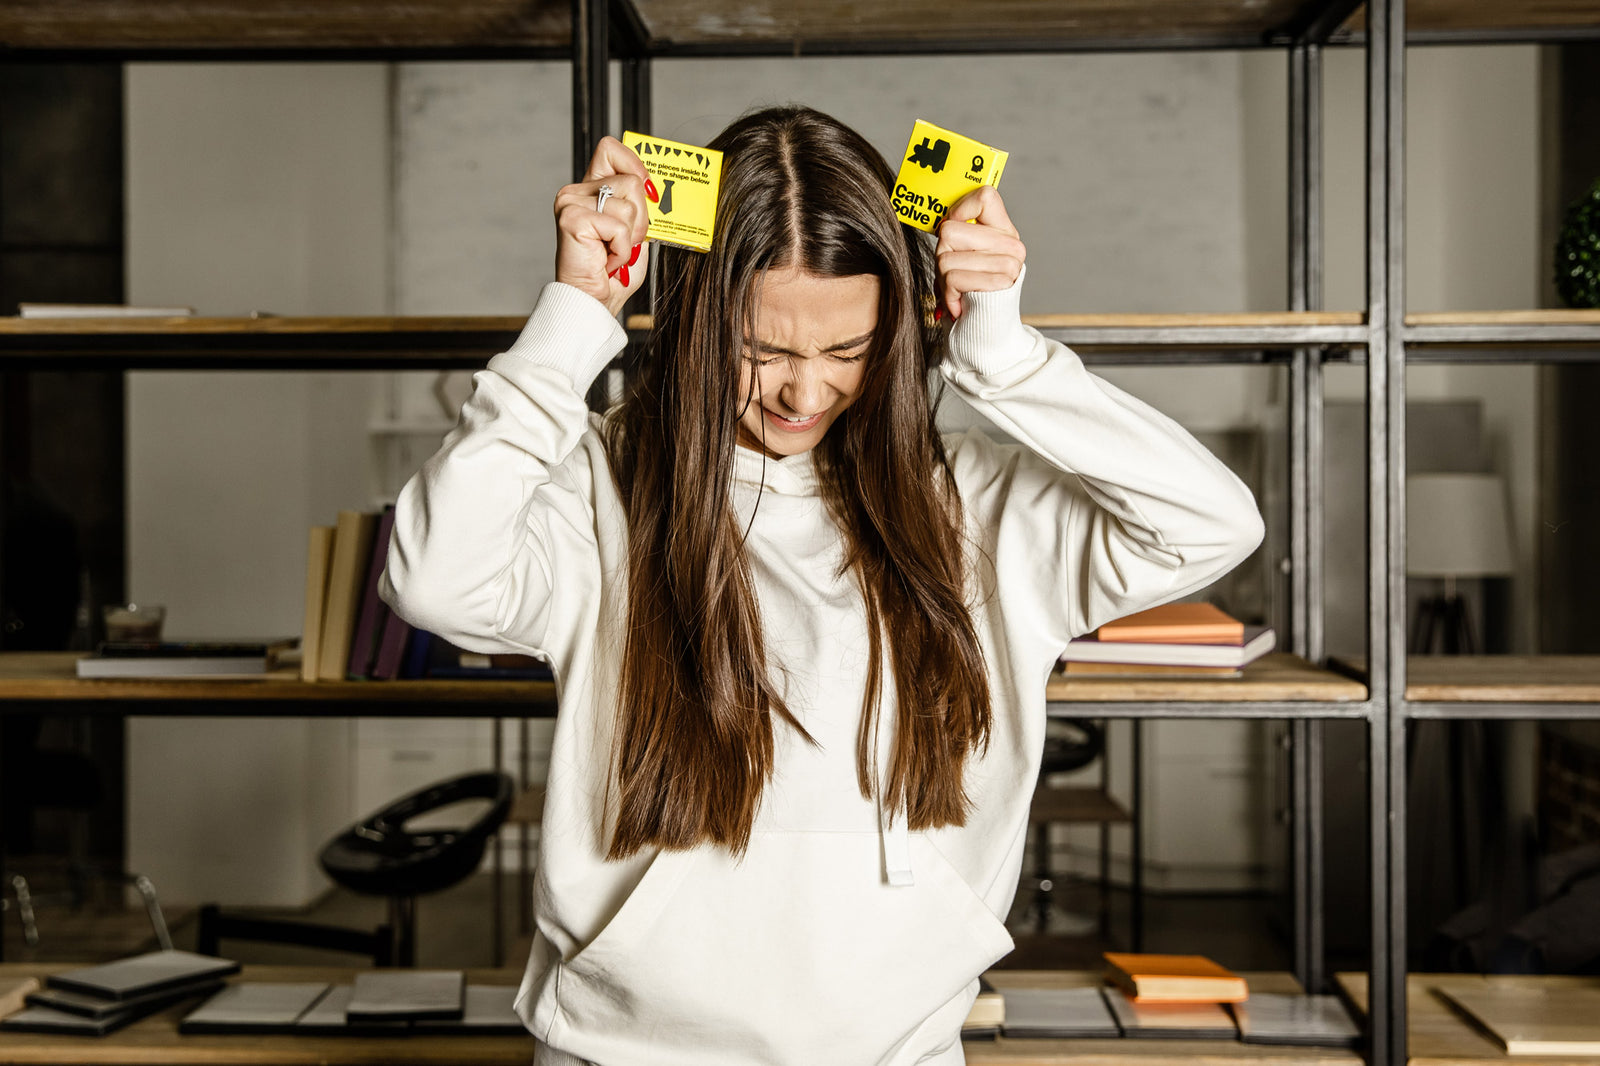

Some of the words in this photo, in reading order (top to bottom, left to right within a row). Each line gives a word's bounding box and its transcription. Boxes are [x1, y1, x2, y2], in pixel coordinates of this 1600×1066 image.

[658, 164, 680, 172] pieces
[680, 167, 700, 176] inside
[670, 172, 690, 180] shape
[690, 175, 710, 185] below
[964, 172, 982, 184] Level
[896, 184, 924, 206] Can
[892, 198, 930, 225] Solve
